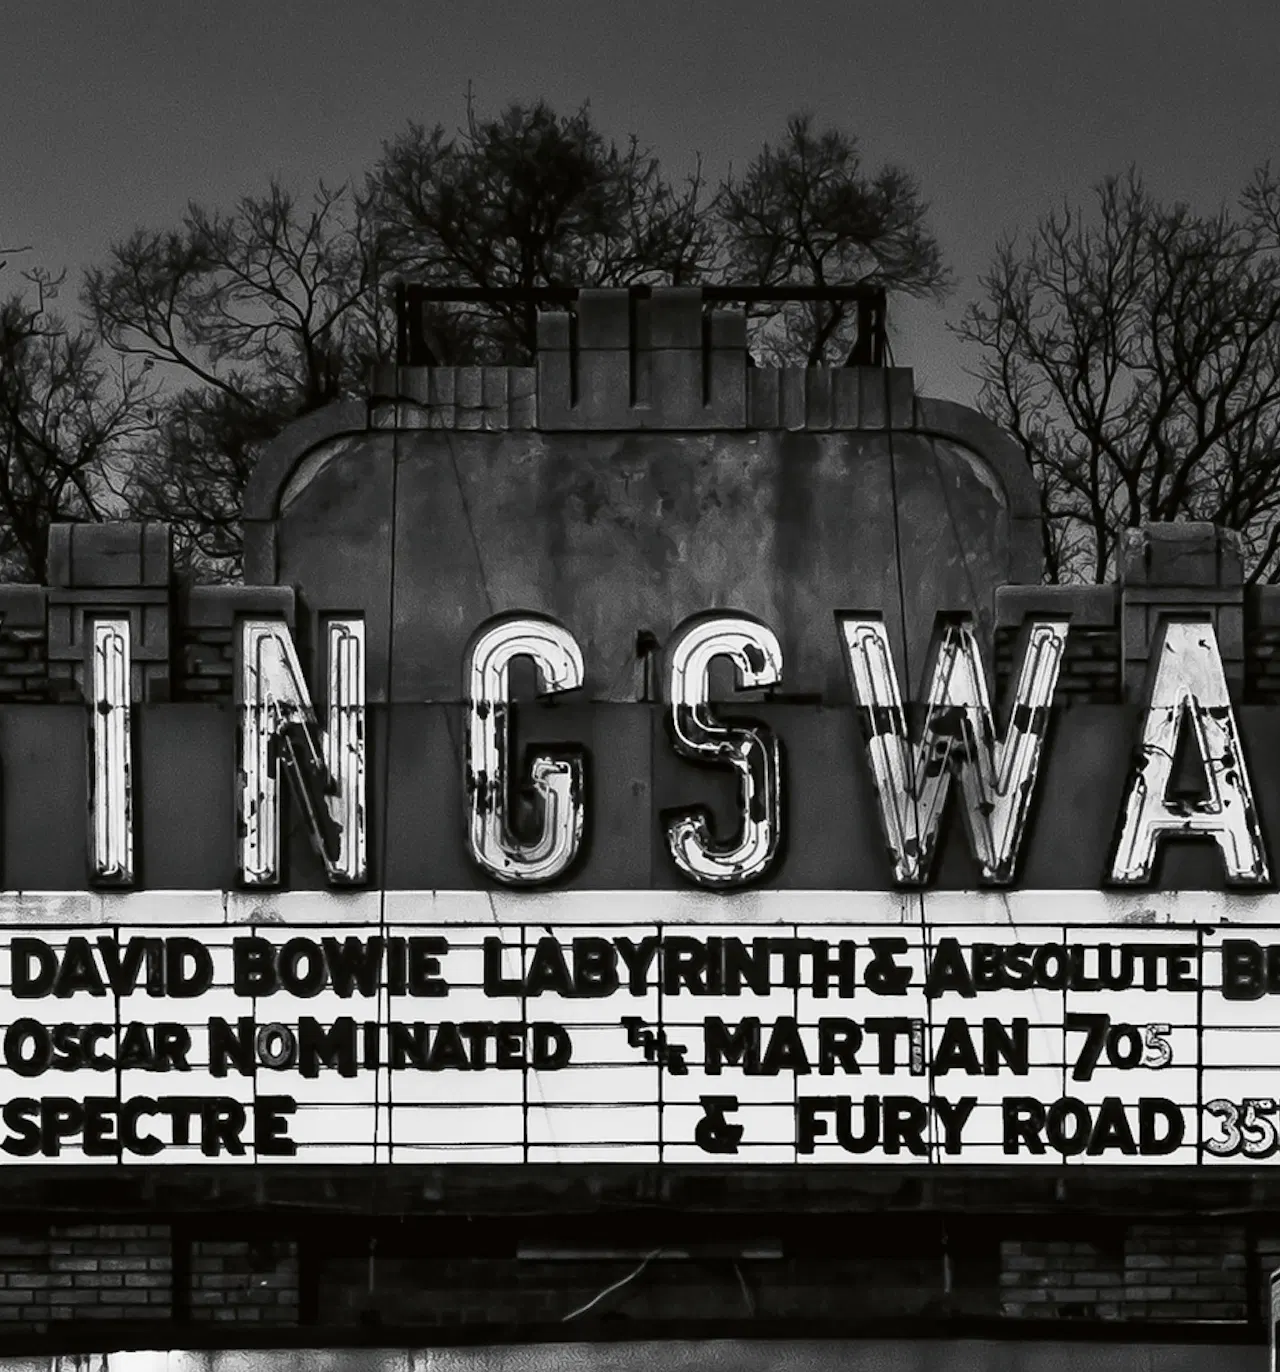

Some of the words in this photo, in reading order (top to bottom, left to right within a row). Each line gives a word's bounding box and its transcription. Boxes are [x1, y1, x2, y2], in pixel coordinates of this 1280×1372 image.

[10, 936, 213, 998] DAVID
[232, 936, 449, 998] BOWIE
[483, 936, 857, 998] LABYRINTH
[863, 937, 913, 997] &
[924, 937, 1198, 998] ABSOLUTE
[4, 1017, 192, 1078] OSCAR
[208, 1016, 571, 1079] NOMINATED
[704, 1016, 1030, 1077] MARTIAN
[1064, 1013, 1173, 1081] 705
[1, 1096, 298, 1158] SPECTRE
[695, 1096, 745, 1155] &
[796, 1096, 979, 1157] FURY
[1002, 1096, 1185, 1157] ROAD
